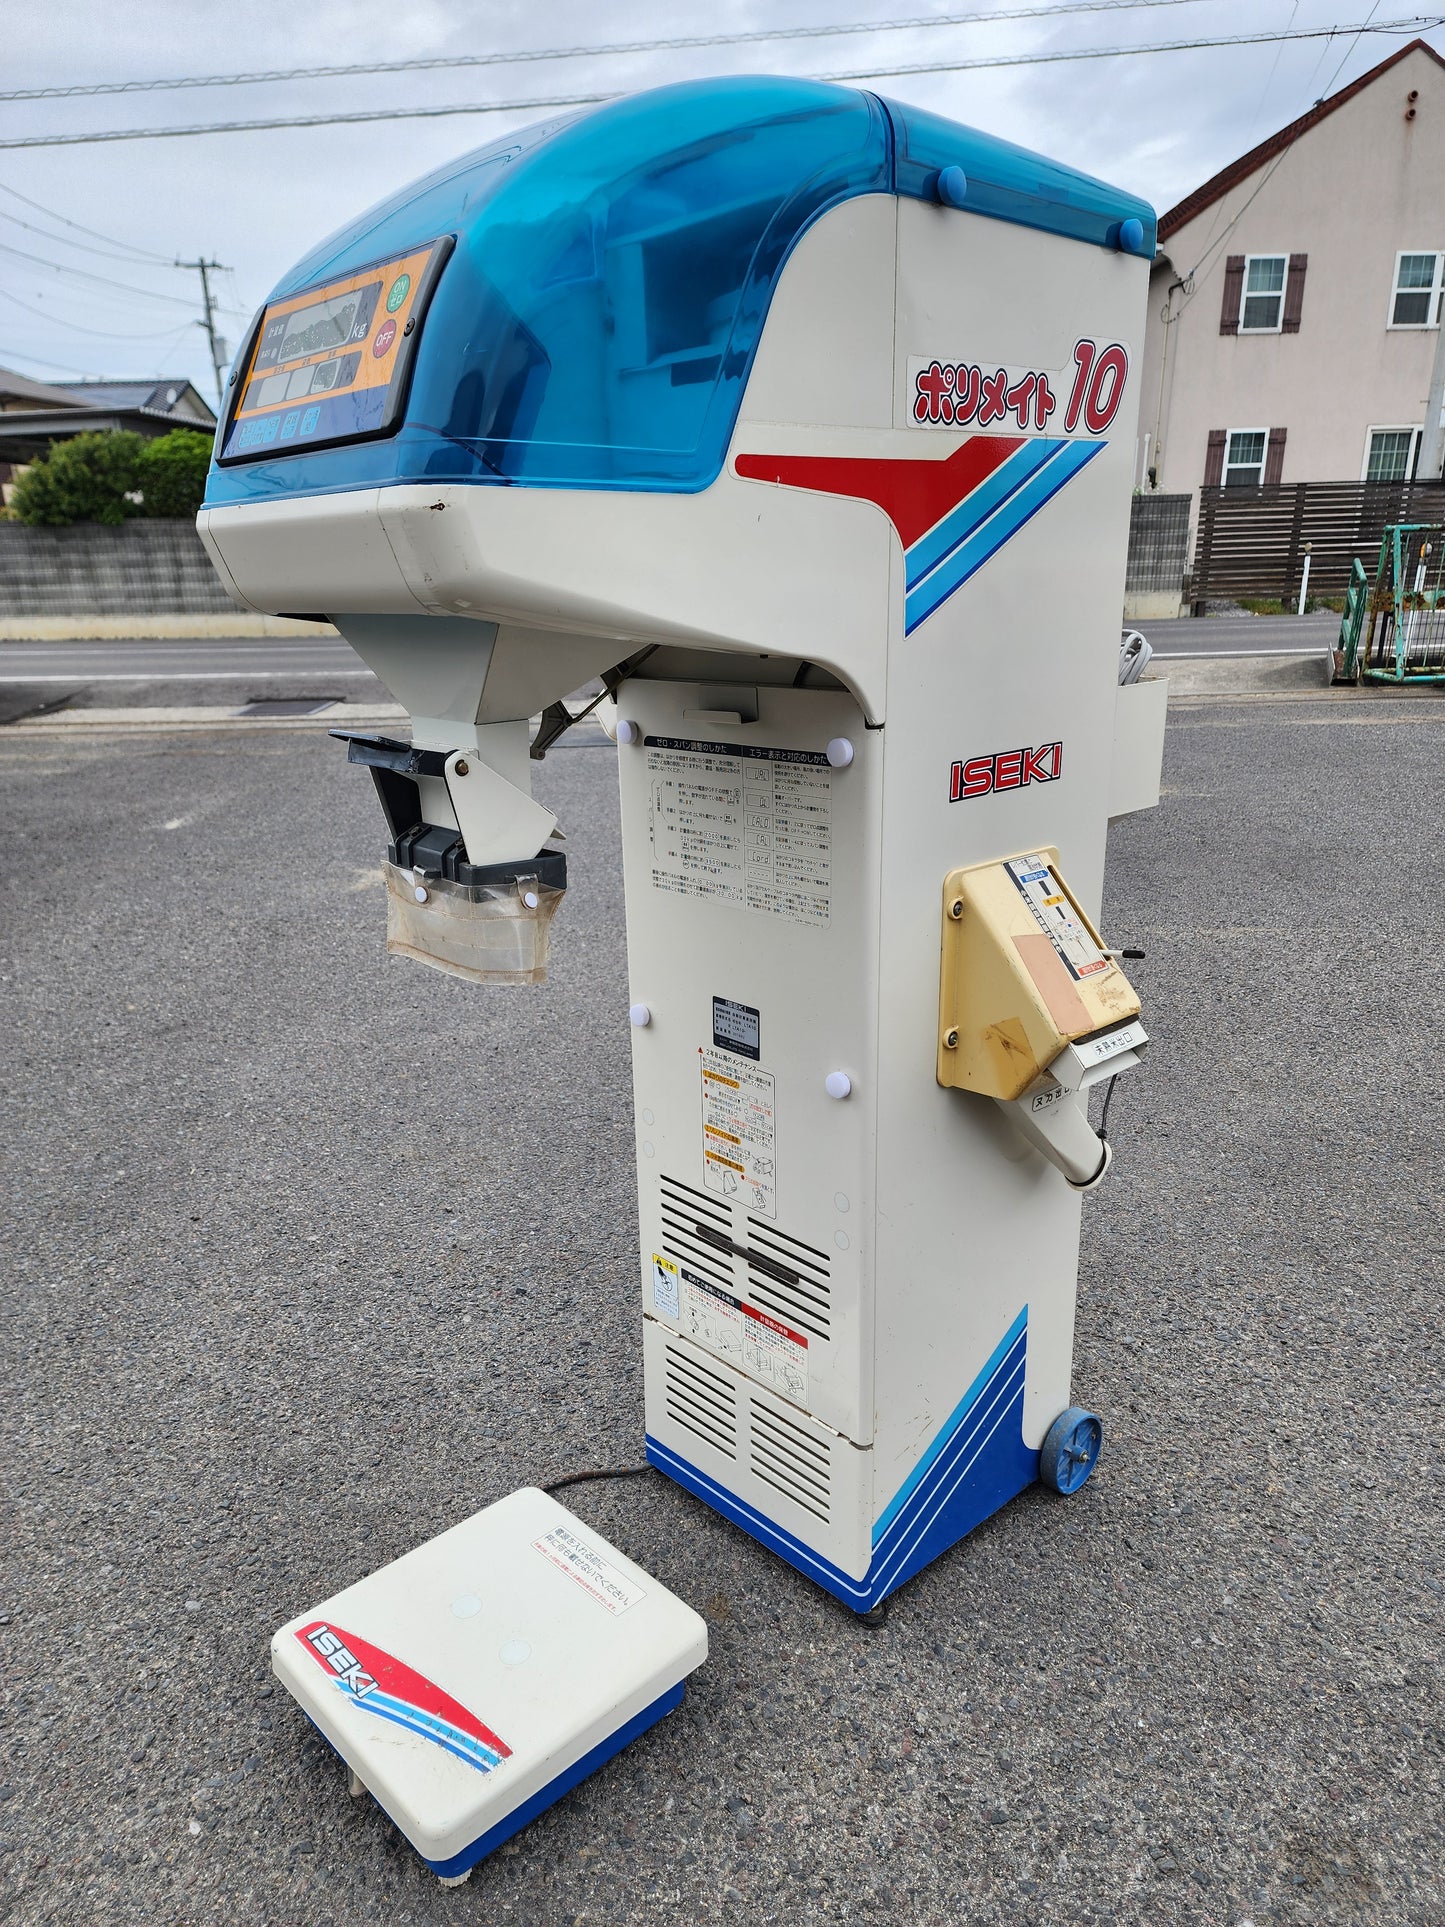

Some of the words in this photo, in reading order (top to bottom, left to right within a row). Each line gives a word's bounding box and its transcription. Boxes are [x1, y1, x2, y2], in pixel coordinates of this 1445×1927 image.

[394, 279, 407, 292] ON
[351, 323, 367, 339] kg
[375, 330, 394, 346] OFF
[913, 360, 1056, 430] ポリメイト
[1064, 339, 1128, 434] 10
[656, 738, 727, 753] ゼロ・スパン調整のしかた
[750, 749, 827, 764] エラー表示と対応のしかた
[949, 741, 1063, 803] ISEKI
[1095, 1032, 1133, 1056] 未熟米出口
[554, 1528, 607, 1571] 電源を入れる前に
[306, 1623, 379, 1700] ISEKI
